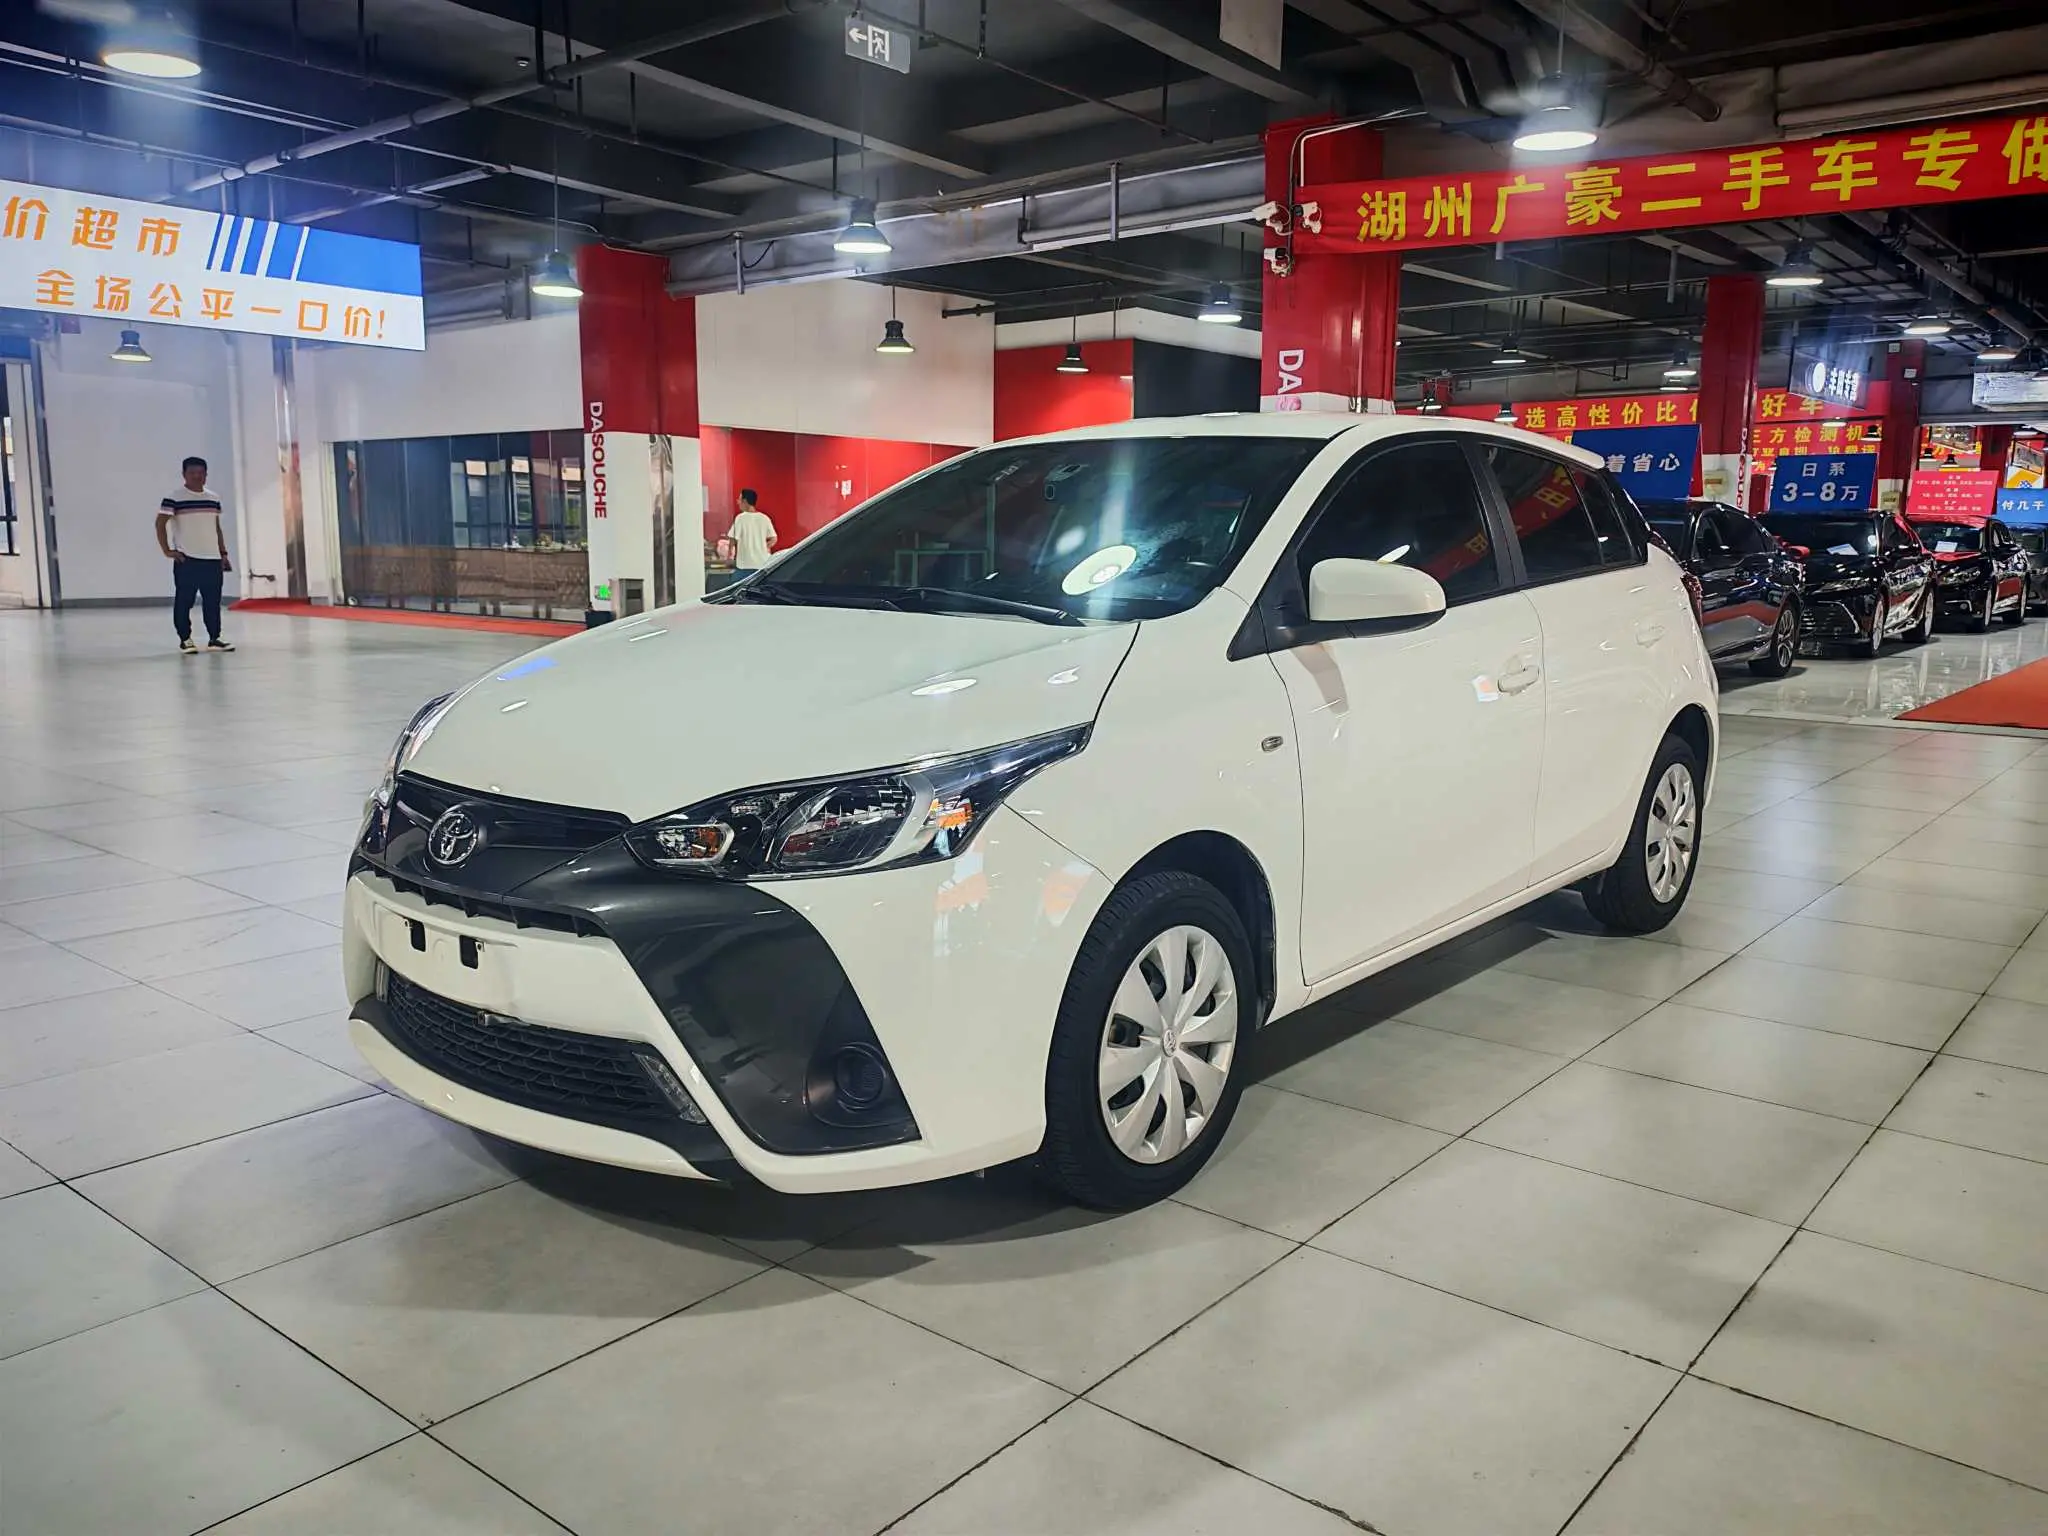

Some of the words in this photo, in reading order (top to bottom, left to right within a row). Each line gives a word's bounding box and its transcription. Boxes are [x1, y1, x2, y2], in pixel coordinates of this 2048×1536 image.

[1356, 116, 2048, 242] 湖州广豪二手车专做
[3, 196, 182, 256] 价超市
[36, 269, 386, 339] 全场公平一口价!
[589, 400, 607, 519] DASOUCHE
[1802, 461, 1847, 477] 日系
